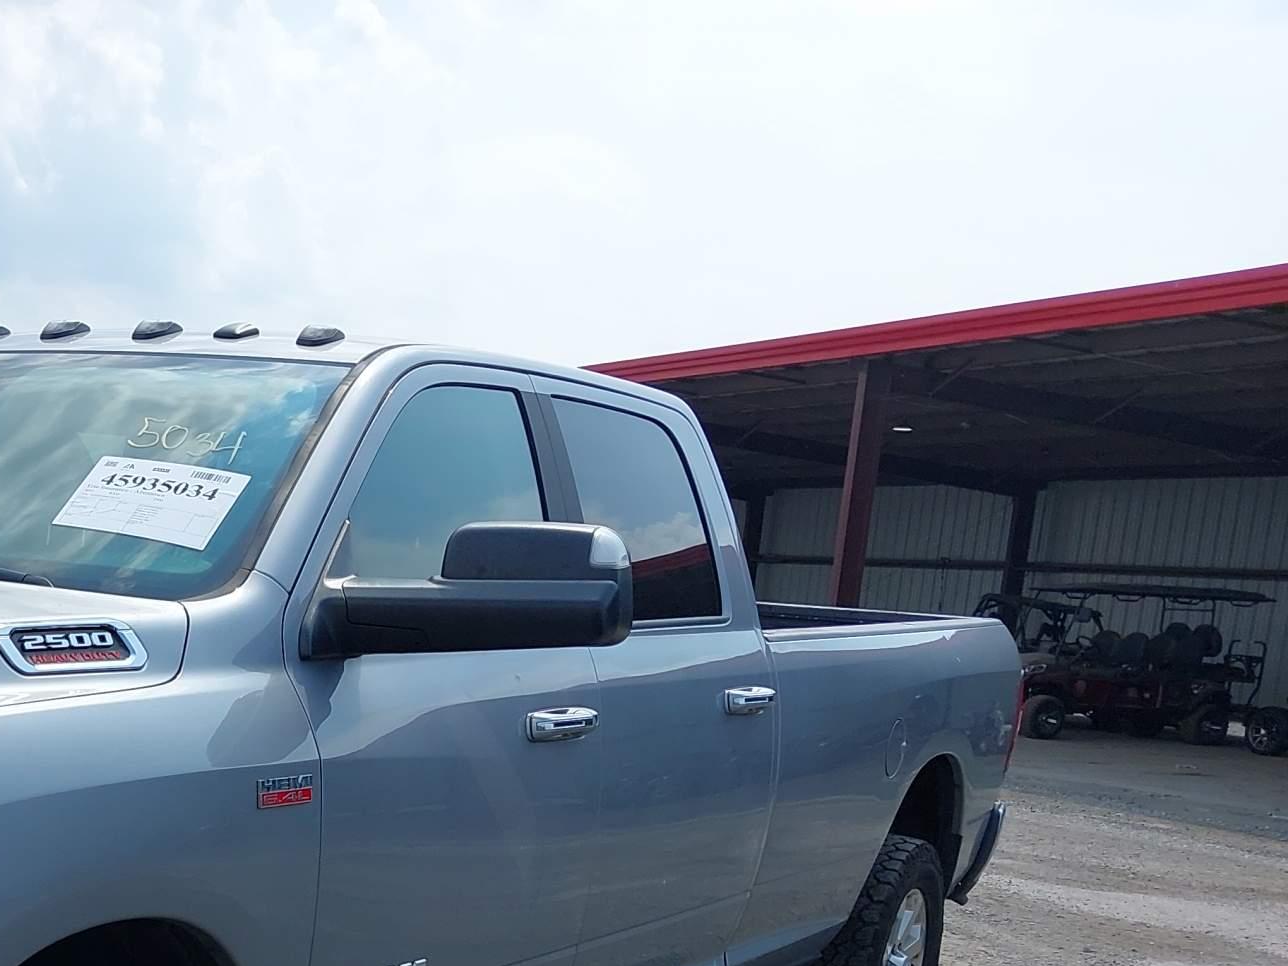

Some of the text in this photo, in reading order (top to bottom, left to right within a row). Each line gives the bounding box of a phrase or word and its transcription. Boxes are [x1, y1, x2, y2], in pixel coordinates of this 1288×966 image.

[127, 416, 247, 465] 5034
[100, 472, 220, 501] 45935034
[22, 631, 115, 650] 2500
